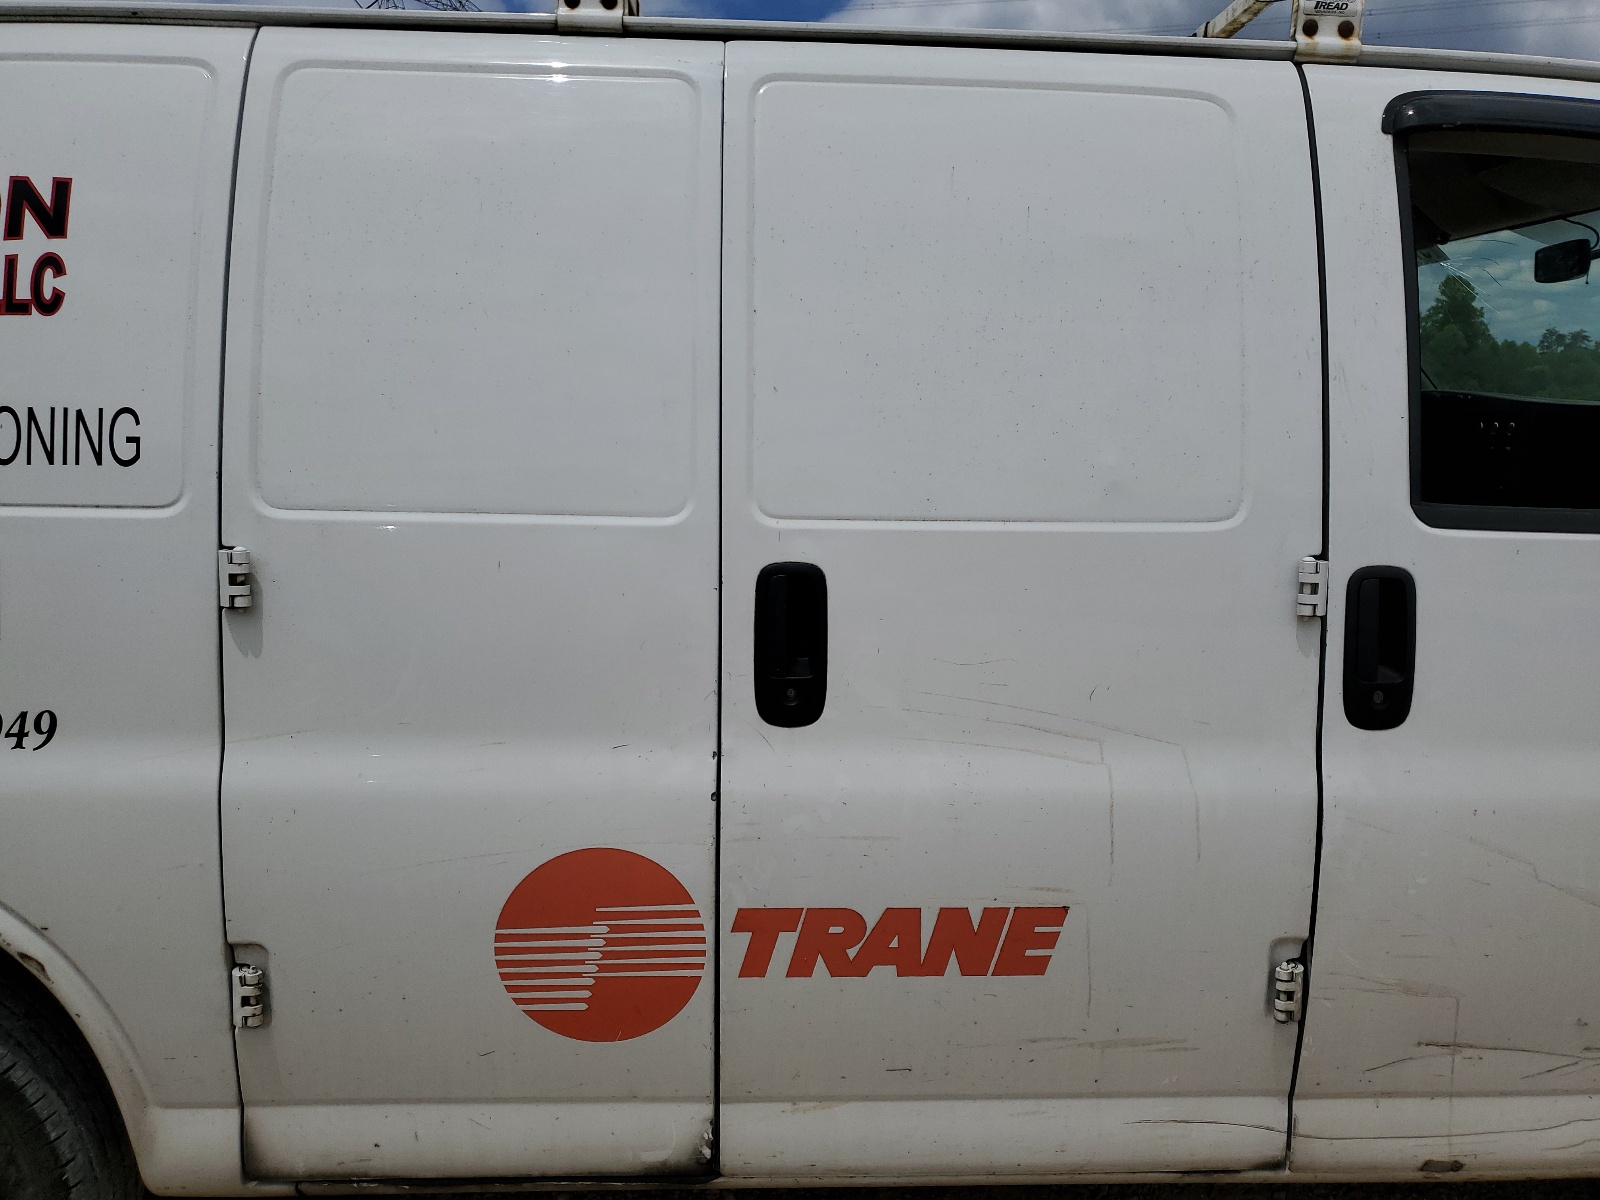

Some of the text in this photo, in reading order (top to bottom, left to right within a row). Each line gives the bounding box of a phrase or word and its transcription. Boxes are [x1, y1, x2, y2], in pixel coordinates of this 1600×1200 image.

[0, 175, 73, 241] N
[0, 251, 67, 317] LC
[0, 709, 58, 751] 49
[731, 906, 1070, 978] TRANE
